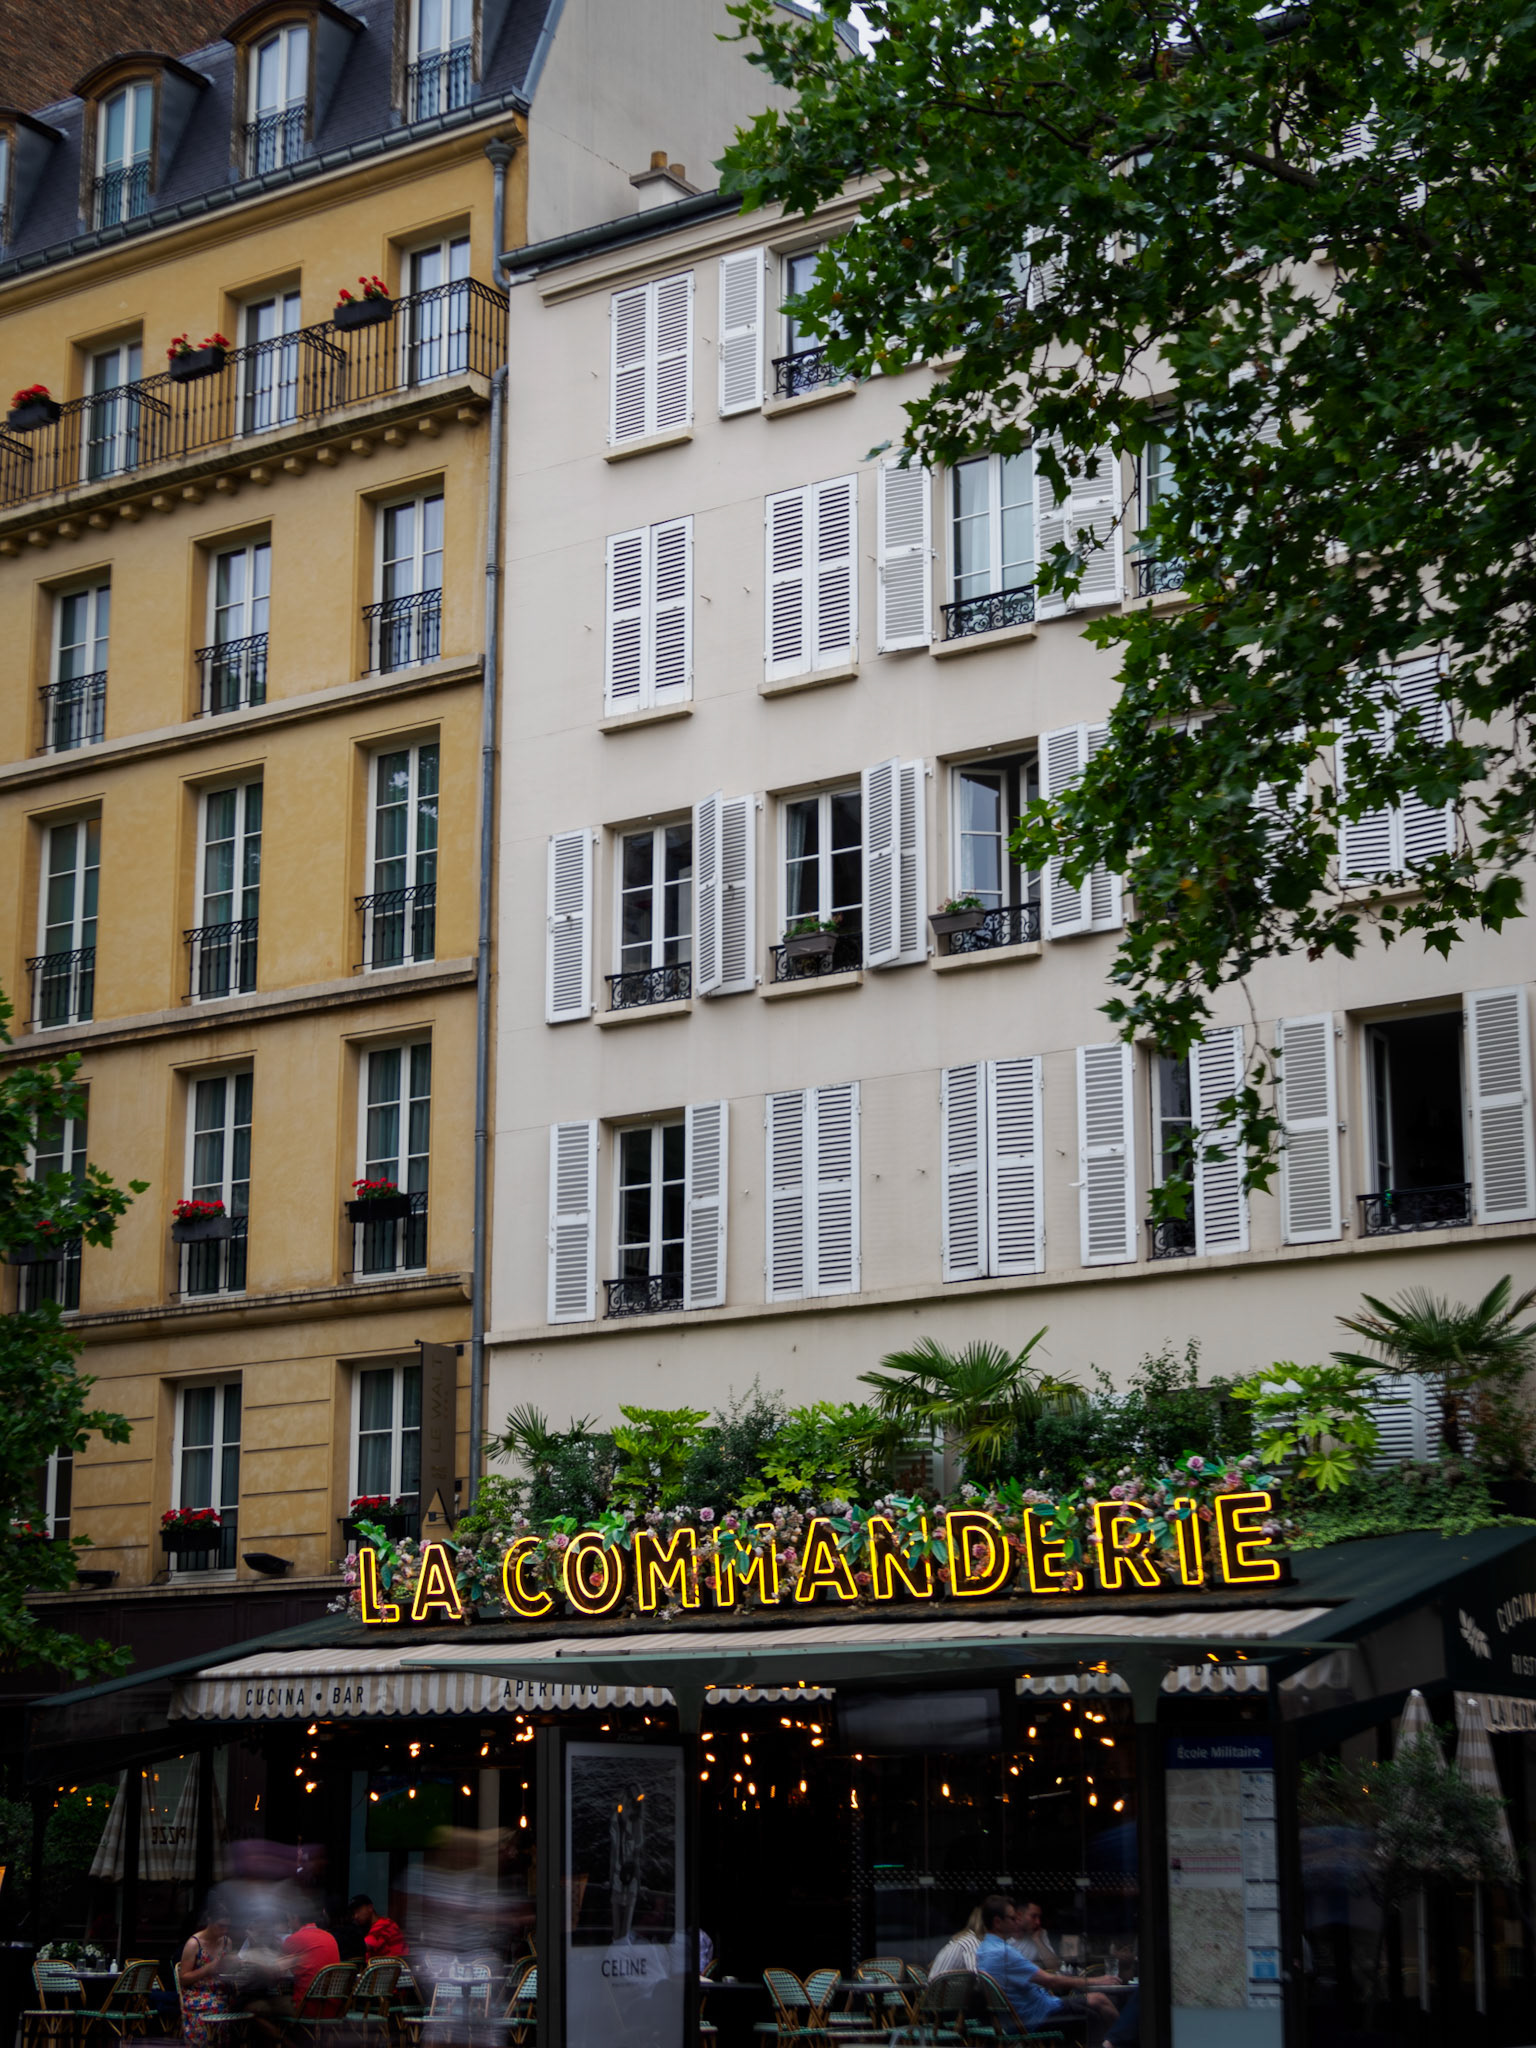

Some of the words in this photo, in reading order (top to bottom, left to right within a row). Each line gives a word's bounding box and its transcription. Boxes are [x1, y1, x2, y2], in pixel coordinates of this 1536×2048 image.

[431, 1354, 443, 1420] WALT
[431, 1427, 442, 1453] LE
[359, 1543, 462, 1624] LA
[503, 1490, 1282, 1618] COMMANDERIE
[1511, 1653, 1536, 1678] RIST
[246, 1687, 305, 1707] CUCINA
[332, 1685, 364, 1704] BAR
[1488, 1699, 1506, 1726] LA
[1176, 1744, 1209, 1760] École
[1210, 1744, 1262, 1759] Militaire
[601, 1958, 647, 1978] CELINE
